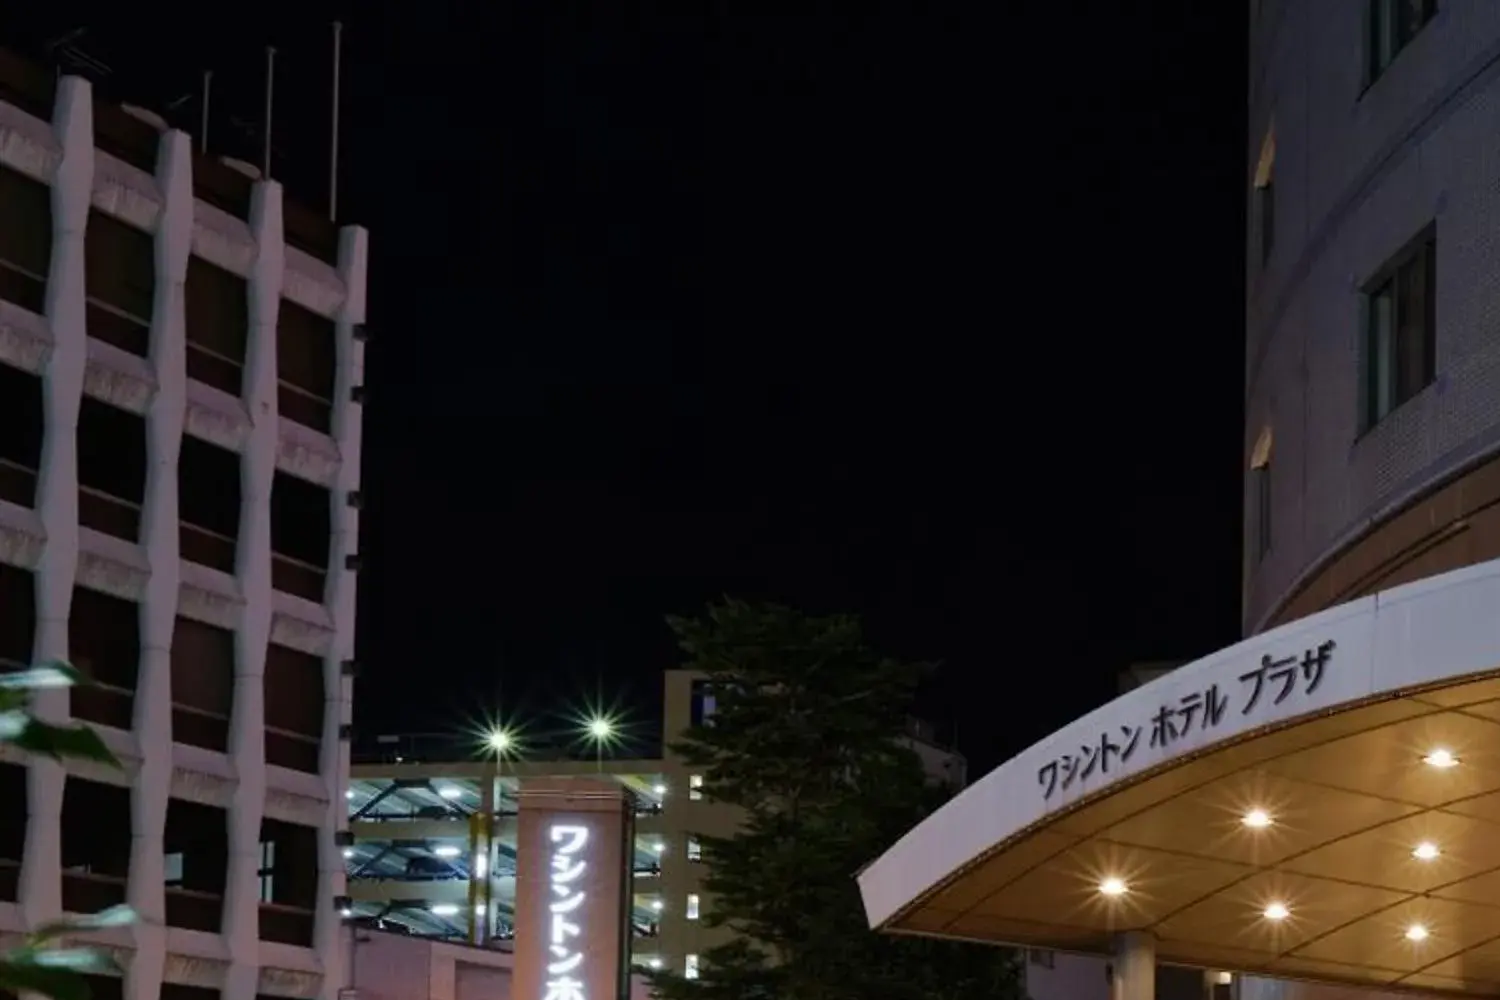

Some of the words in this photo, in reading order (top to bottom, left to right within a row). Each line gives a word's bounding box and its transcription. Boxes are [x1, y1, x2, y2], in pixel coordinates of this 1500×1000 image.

[1039, 725, 1143, 800] ワシントン
[1150, 683, 1229, 750] ホテル
[1239, 639, 1336, 715] プラザ
